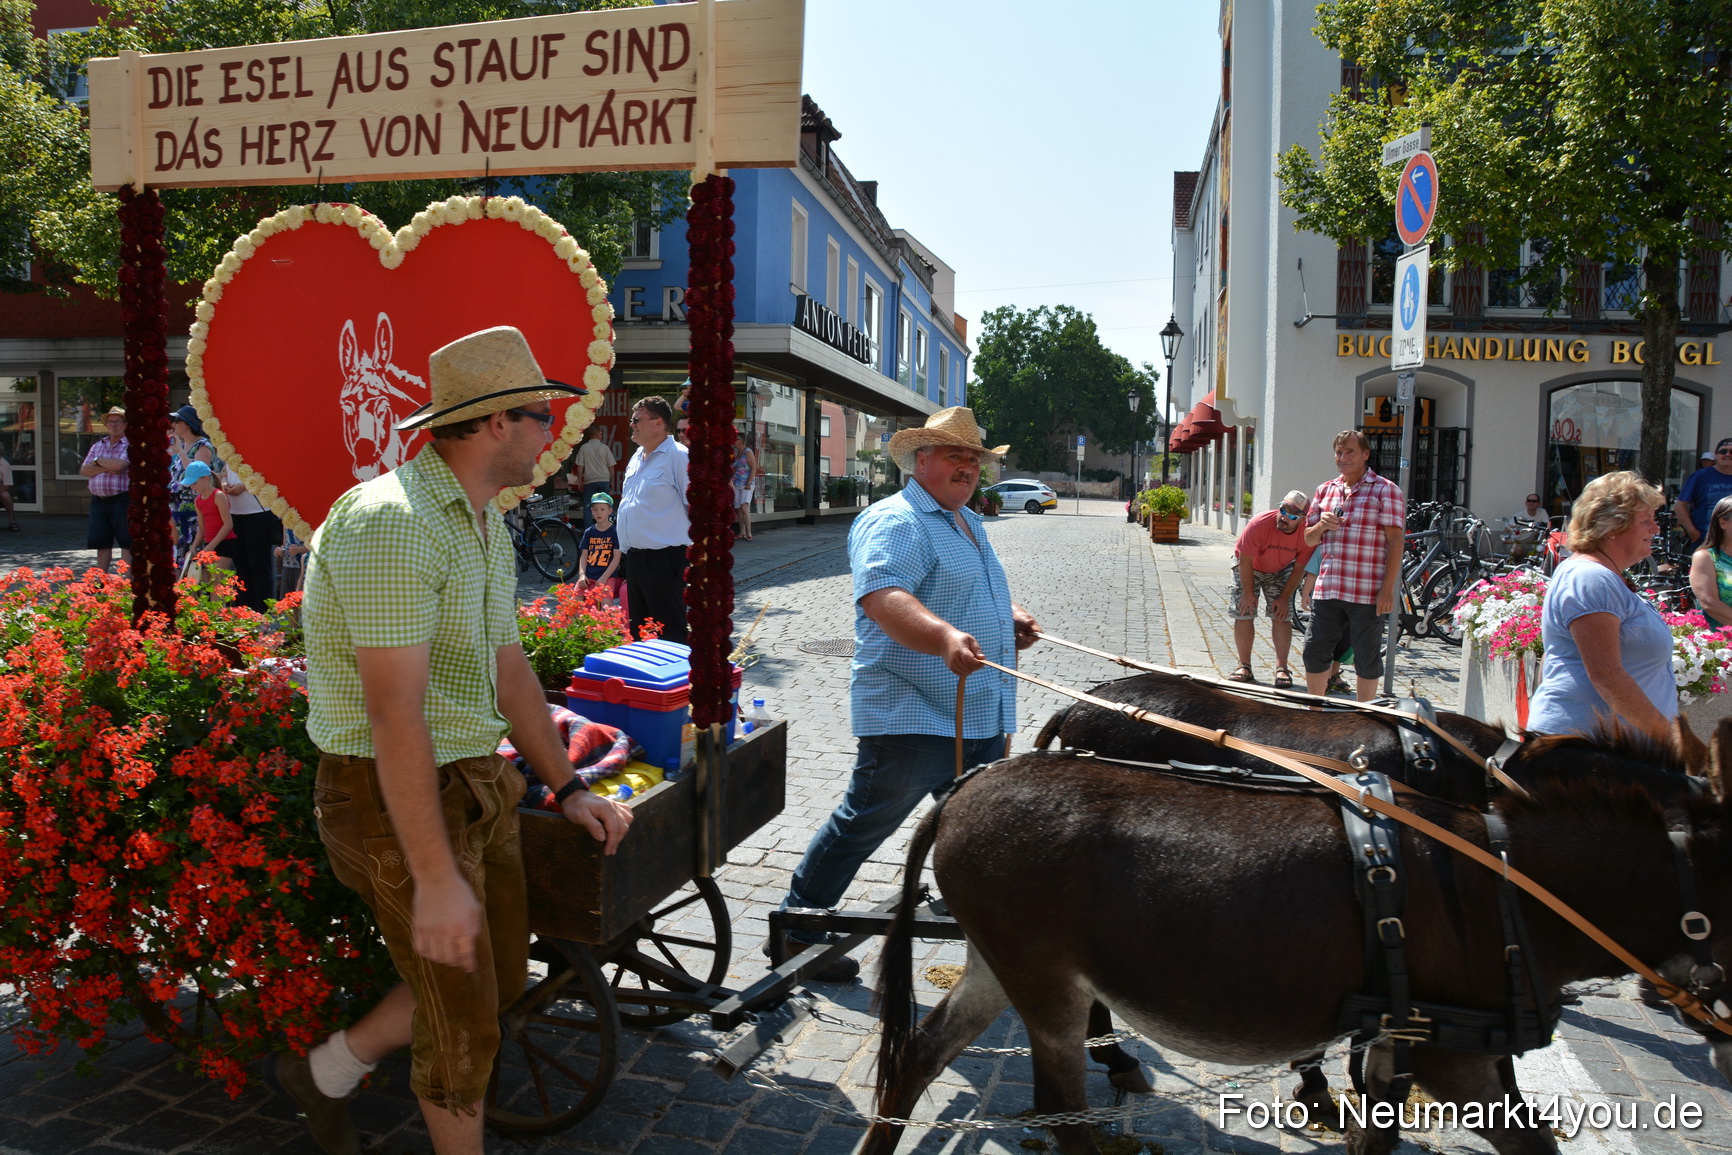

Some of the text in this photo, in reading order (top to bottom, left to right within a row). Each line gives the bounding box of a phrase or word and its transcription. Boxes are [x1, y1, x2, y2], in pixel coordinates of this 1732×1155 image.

[147, 22, 690, 110] DIE ESEL AUS STAUF SIND
[154, 88, 698, 174] DAS HERZ VON NEUMARKT
[802, 296, 844, 348] ANTON
[1337, 333, 1590, 363] BUCHANDLUNG
